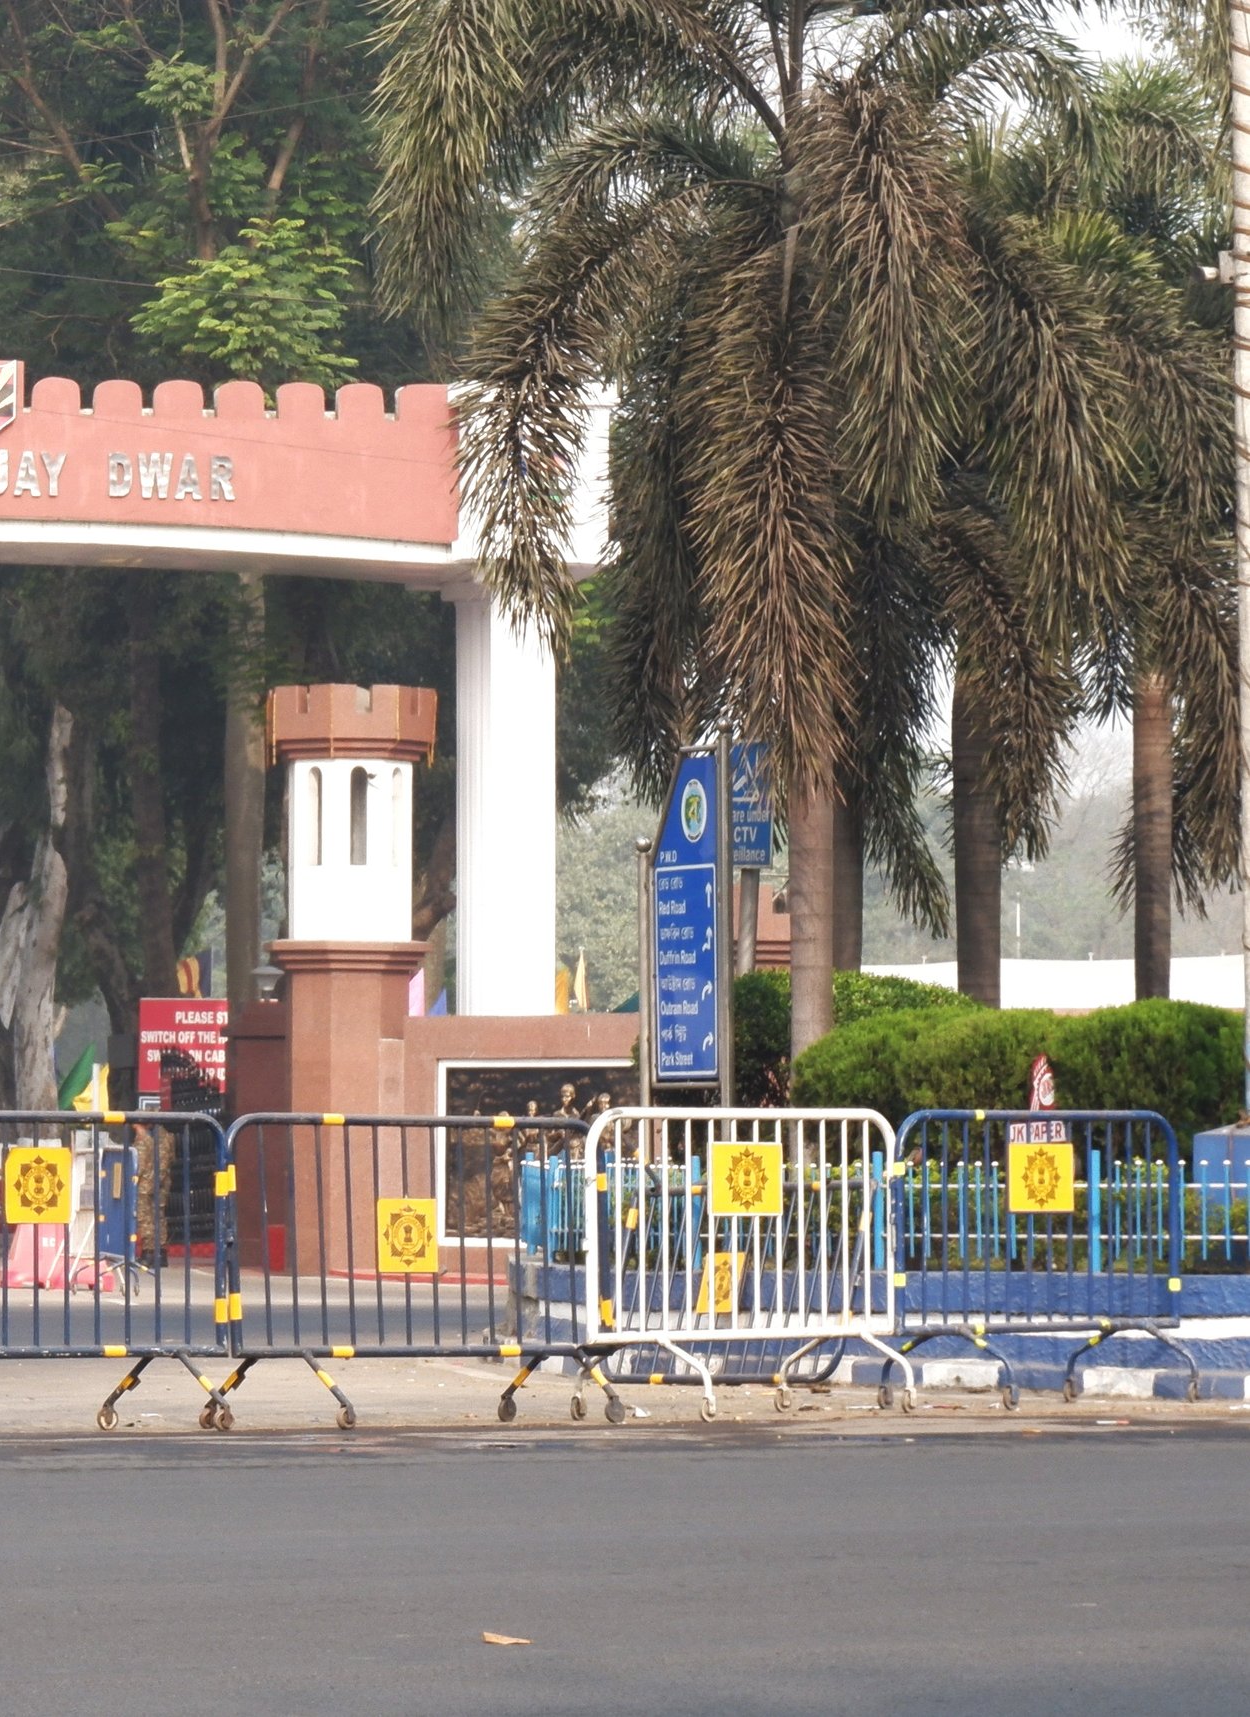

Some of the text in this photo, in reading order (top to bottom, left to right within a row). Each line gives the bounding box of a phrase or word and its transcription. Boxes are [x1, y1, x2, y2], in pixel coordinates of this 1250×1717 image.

[108, 452, 236, 502] DWAR
[658, 899, 686, 915] Red Road
[681, 949, 696, 964] Road
[661, 999, 698, 1015] Outram Road
[175, 1011, 214, 1024] PLEASE
[141, 1030, 176, 1043] SWITCH
[178, 1030, 196, 1043] OFF
[197, 1031, 216, 1043] THE
[661, 1050, 693, 1066] Park Street
[1011, 1125, 1025, 1142] JK
